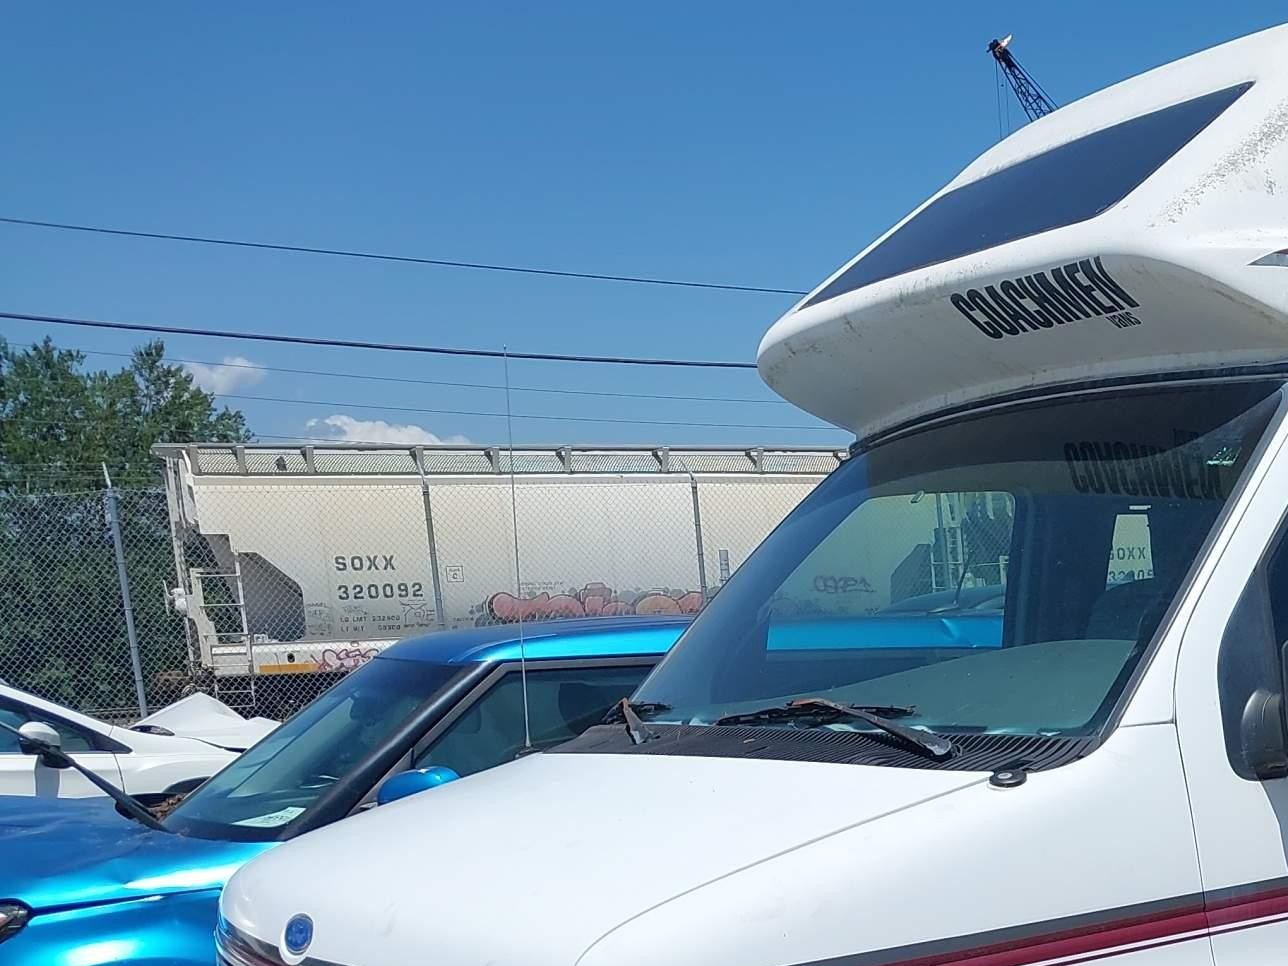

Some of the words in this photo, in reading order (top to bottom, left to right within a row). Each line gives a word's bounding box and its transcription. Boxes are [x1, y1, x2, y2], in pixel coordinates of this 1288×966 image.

[950, 256, 1141, 339] COACHMEN
[335, 555, 396, 571] SOXX
[337, 582, 424, 600] 320092
